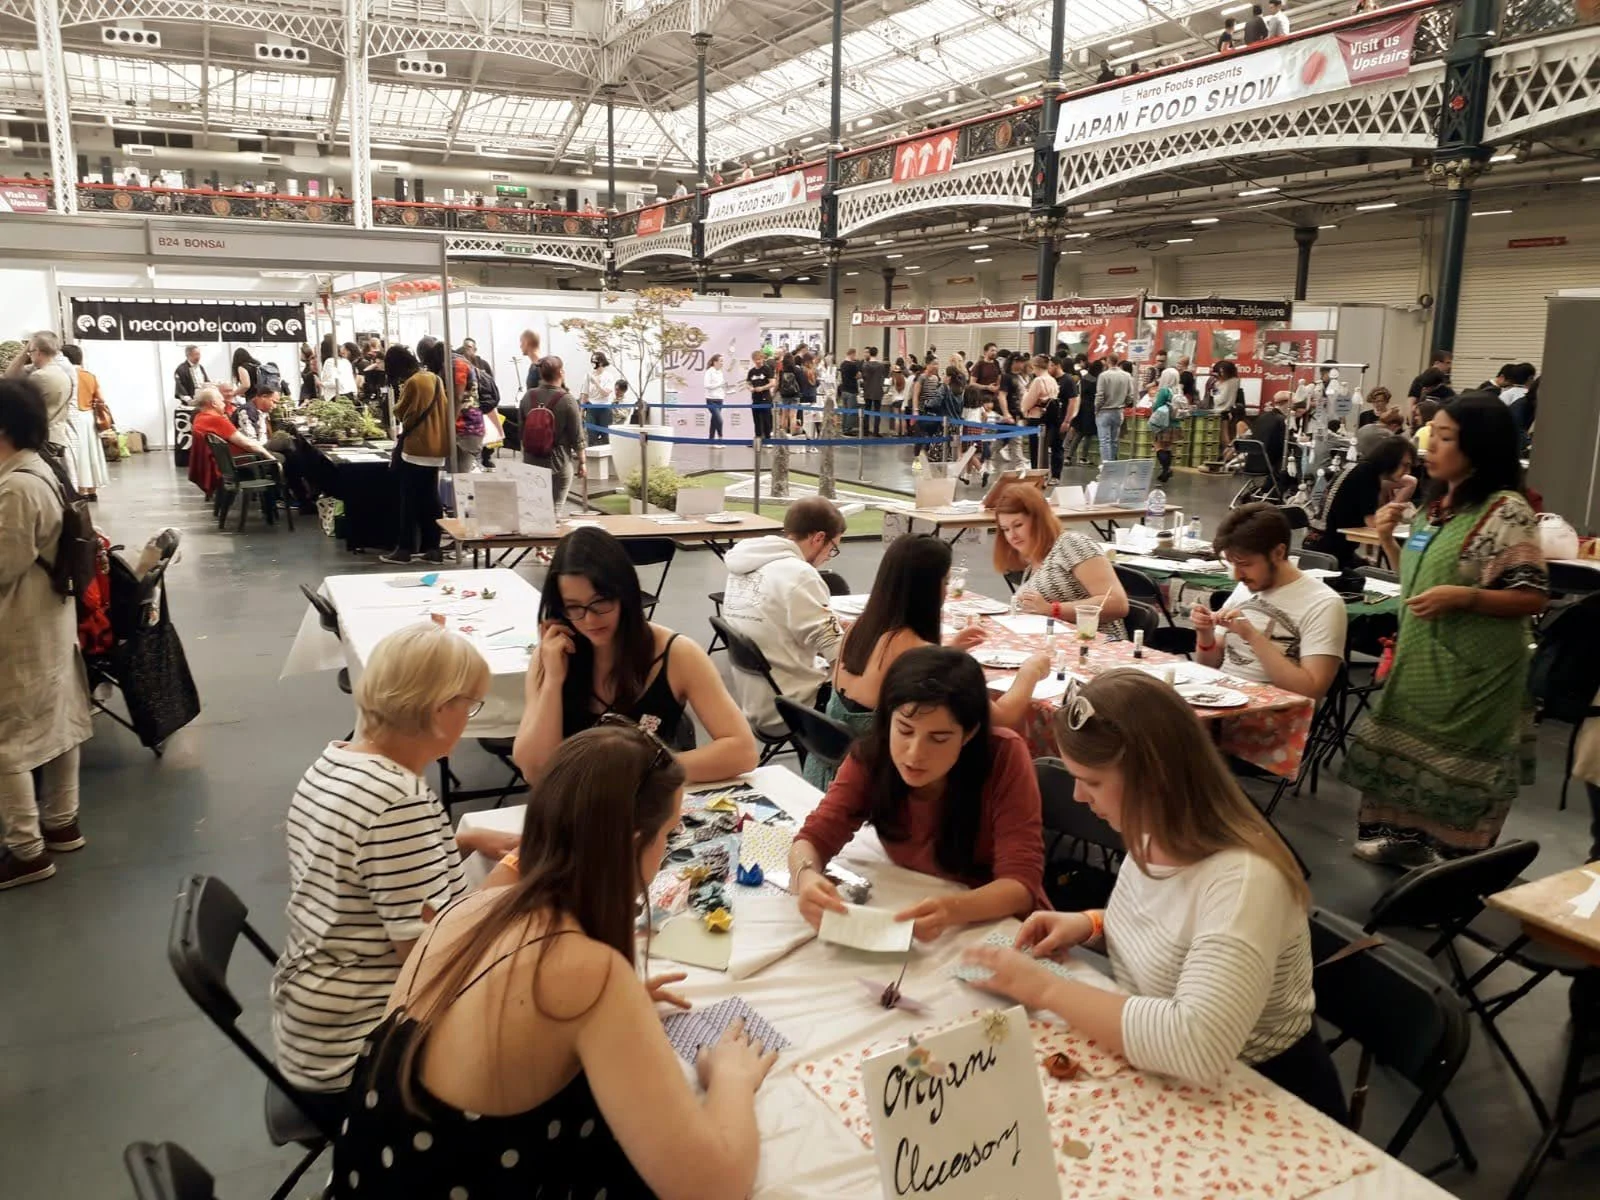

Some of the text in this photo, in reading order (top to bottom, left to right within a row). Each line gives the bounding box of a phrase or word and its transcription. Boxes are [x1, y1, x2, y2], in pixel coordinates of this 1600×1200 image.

[1350, 34, 1400, 55] Visit us
[1352, 49, 1410, 70] Upstairs
[1136, 65, 1243, 101] Harro Foods presents
[1064, 75, 1282, 143] JAPAN FOOD SHOW
[4, 191, 25, 199] Visit
[10, 199, 47, 207] Upstairs
[712, 191, 787, 218] JAPAN FOOD SHOW
[158, 237, 225, 248] B24 BONSAI
[956, 310, 982, 321] Japanese
[1040, 303, 1134, 317] Doki Japanese Tableware
[1170, 304, 1286, 318] Doki Japanese Tableware
[129, 317, 256, 333] neconote.com
[894, 1120, 1021, 1196] Accessory
